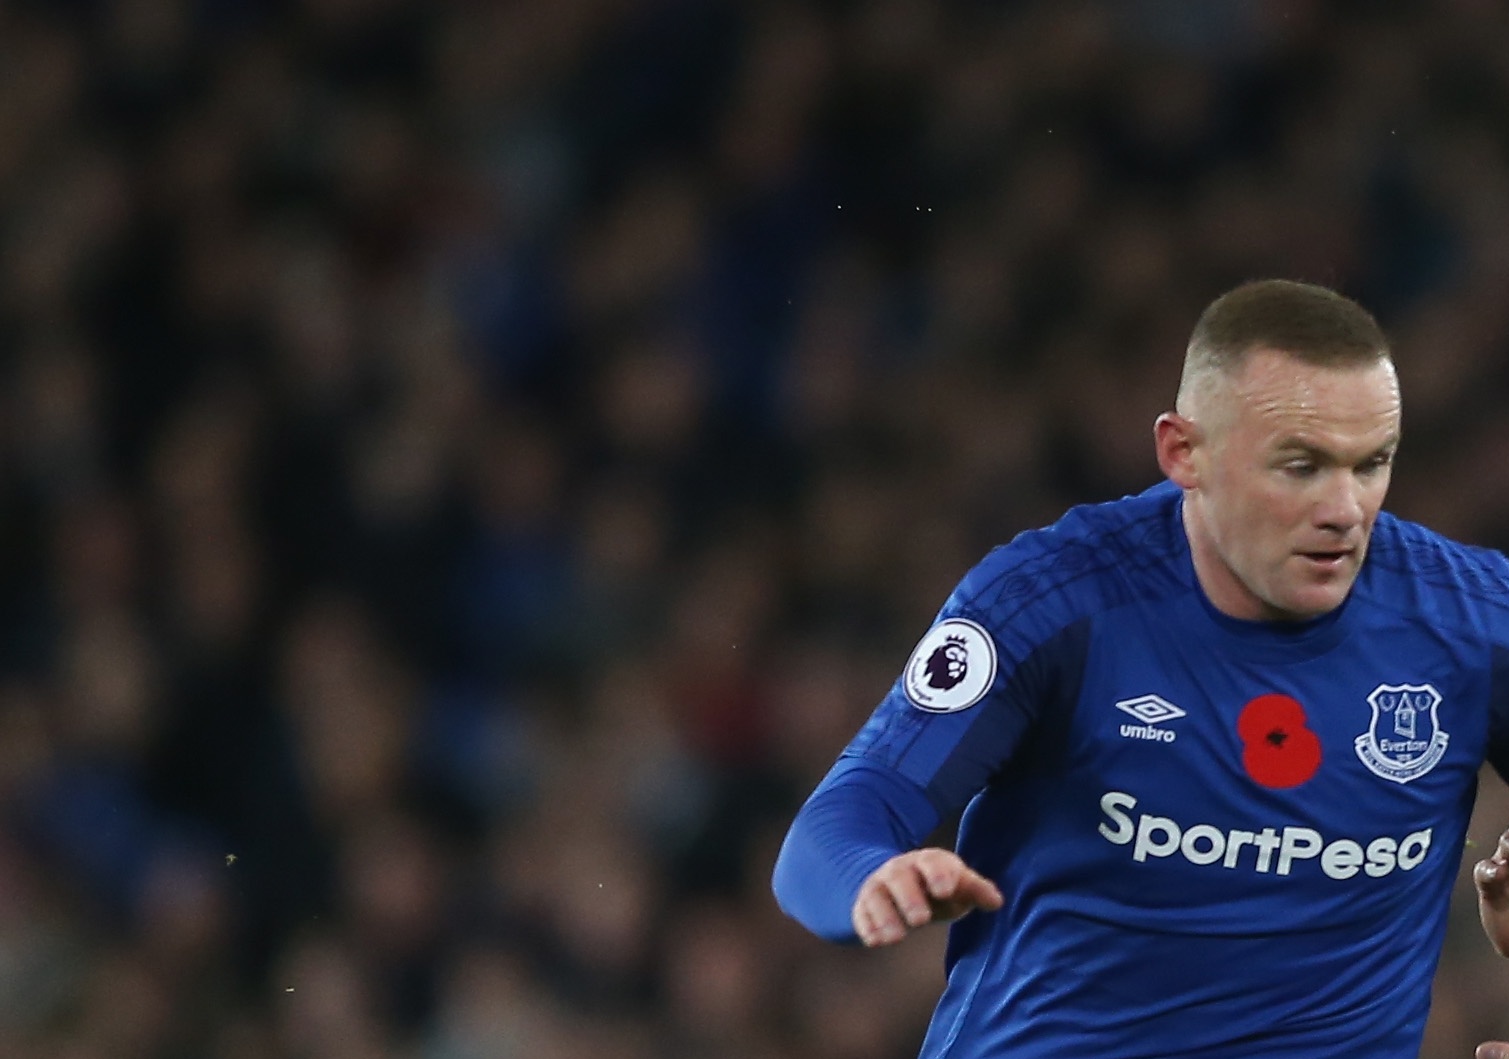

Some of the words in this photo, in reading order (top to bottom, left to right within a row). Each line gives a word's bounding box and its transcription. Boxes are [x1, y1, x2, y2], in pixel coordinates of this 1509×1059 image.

[1120, 725, 1176, 743] umbro
[1380, 738, 1429, 752] Everton
[1098, 791, 1432, 880] SportPesa
